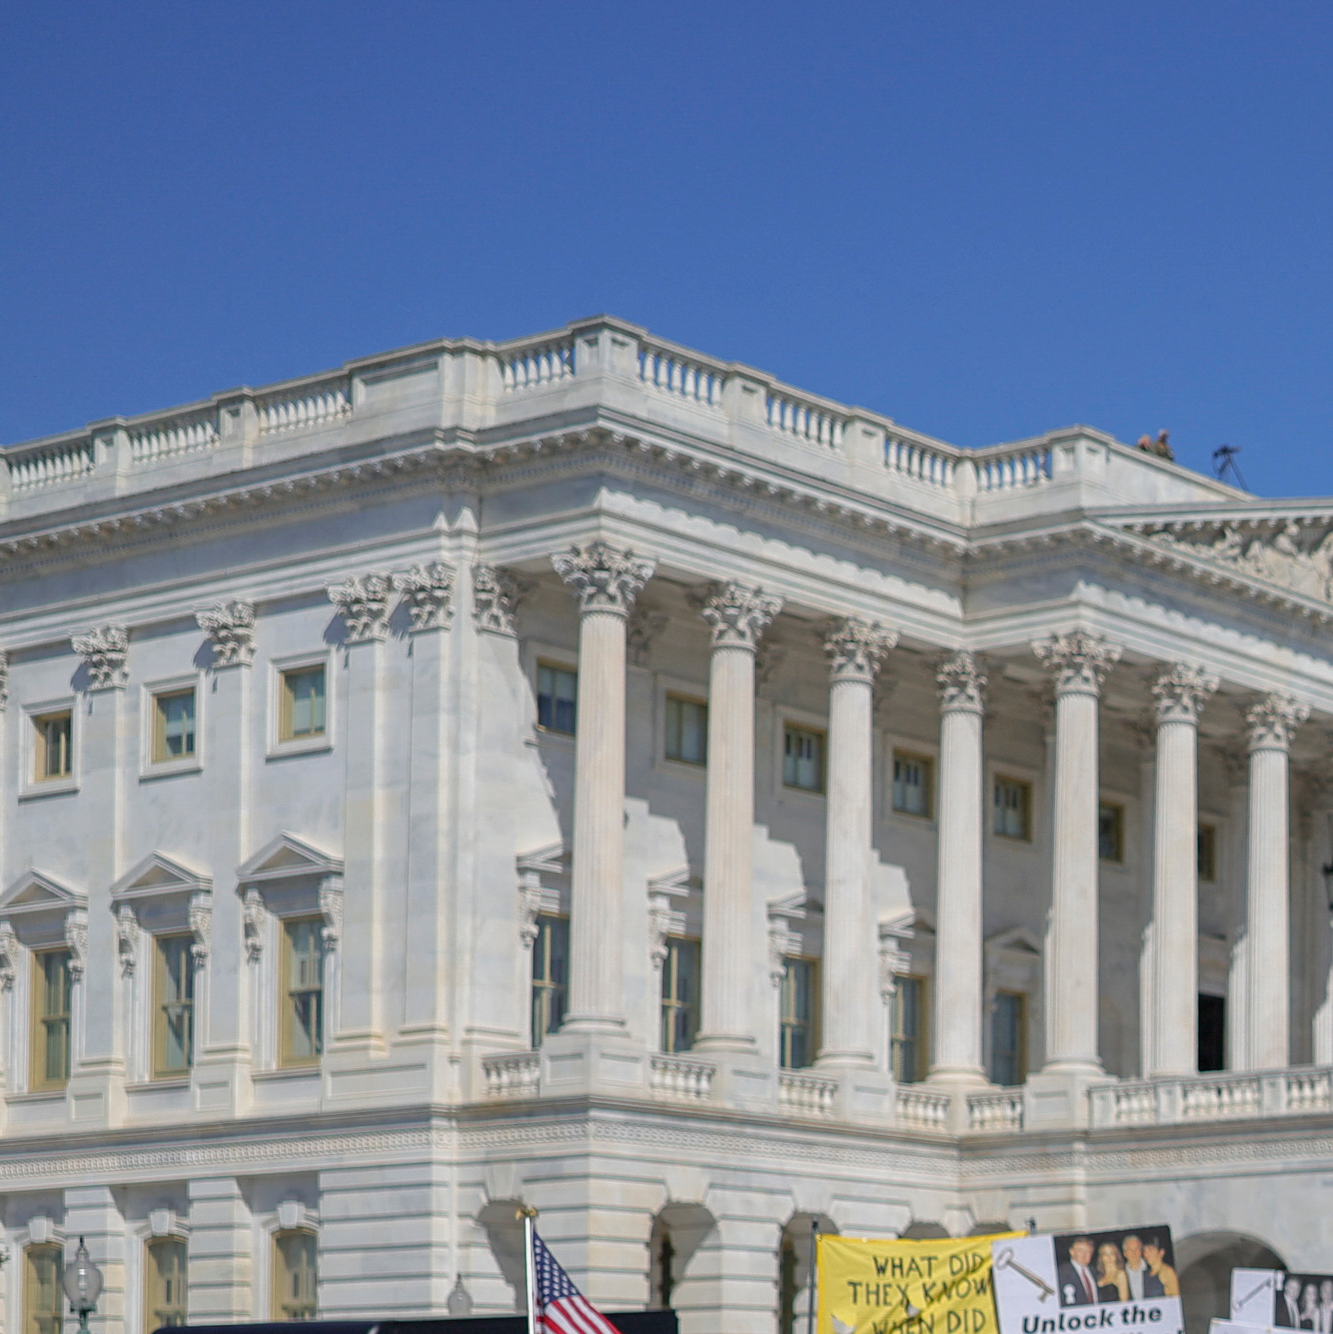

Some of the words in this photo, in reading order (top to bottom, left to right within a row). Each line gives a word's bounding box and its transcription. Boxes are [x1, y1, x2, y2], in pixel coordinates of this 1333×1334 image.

[872, 1255, 939, 1278] WHAT
[949, 1253, 984, 1276] DID
[847, 1281, 910, 1306] THEY
[922, 1277, 989, 1303] KNOW
[947, 1309, 986, 1334] DID
[1022, 1309, 1115, 1334] Unlock
[1121, 1304, 1163, 1325] the
